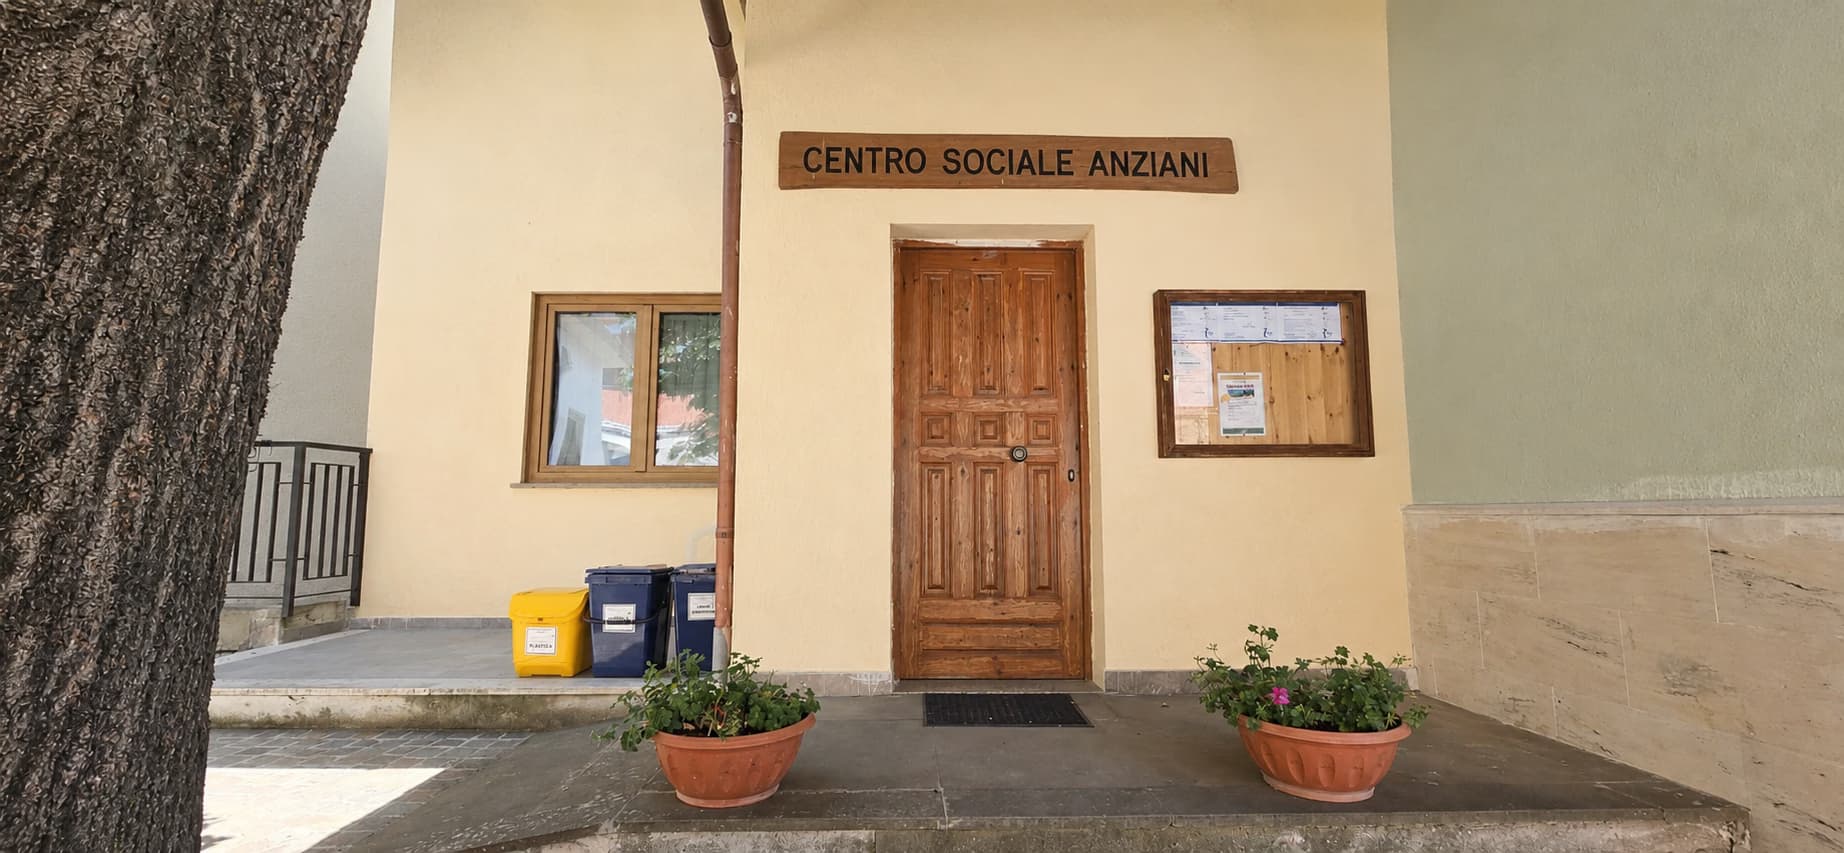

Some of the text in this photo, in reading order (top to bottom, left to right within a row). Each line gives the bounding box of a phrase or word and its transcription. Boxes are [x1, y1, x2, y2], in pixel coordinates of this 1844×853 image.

[802, 146, 1209, 179] CENTRO SOCIALE ANZIANI
